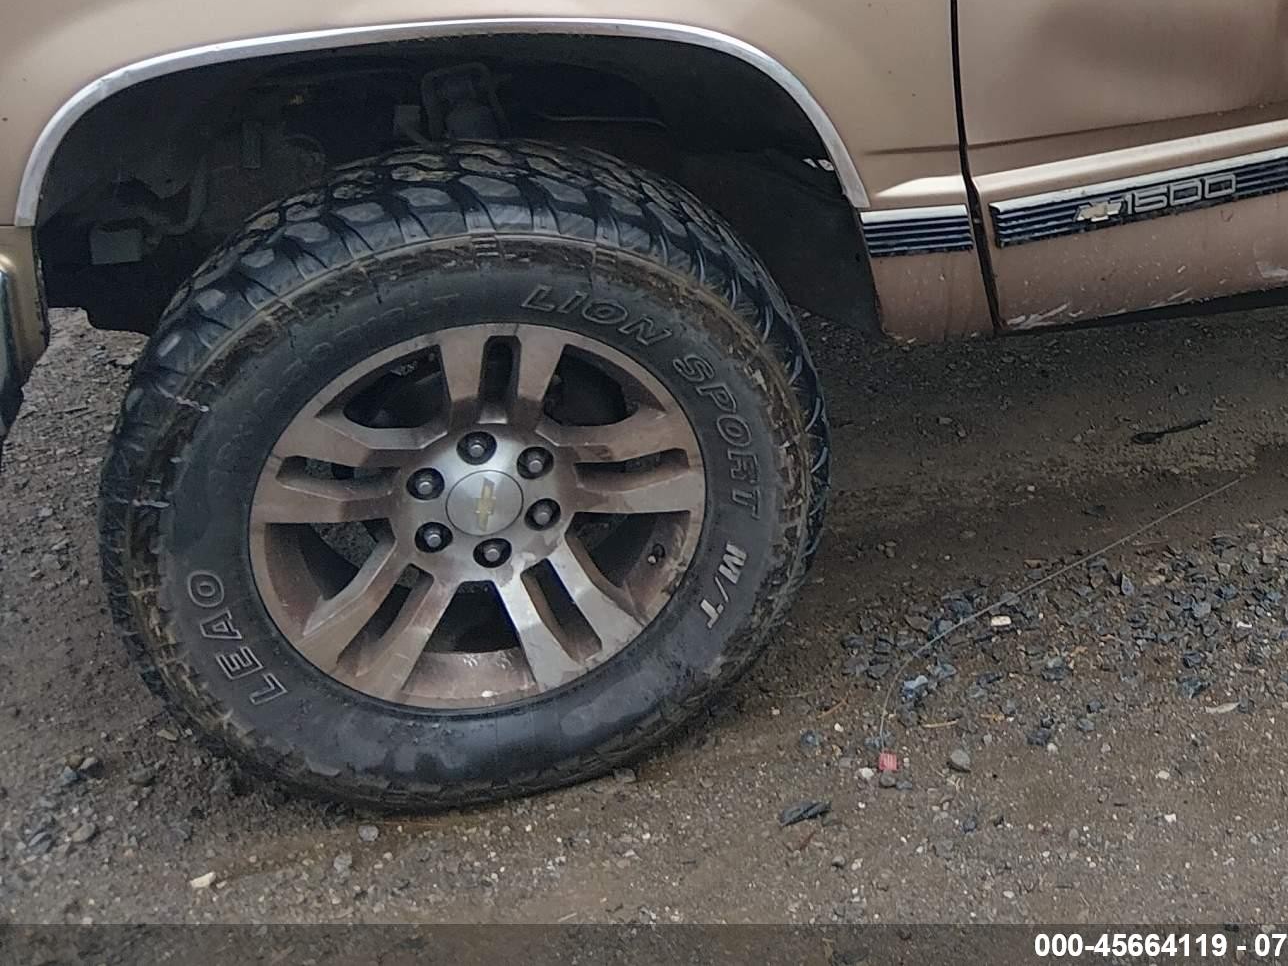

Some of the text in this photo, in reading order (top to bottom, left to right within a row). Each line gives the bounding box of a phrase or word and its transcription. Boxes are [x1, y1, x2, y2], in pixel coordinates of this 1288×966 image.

[1124, 173, 1236, 214] 1500
[520, 284, 762, 630] LION SPORT M/T
[187, 570, 288, 705] LEAO
